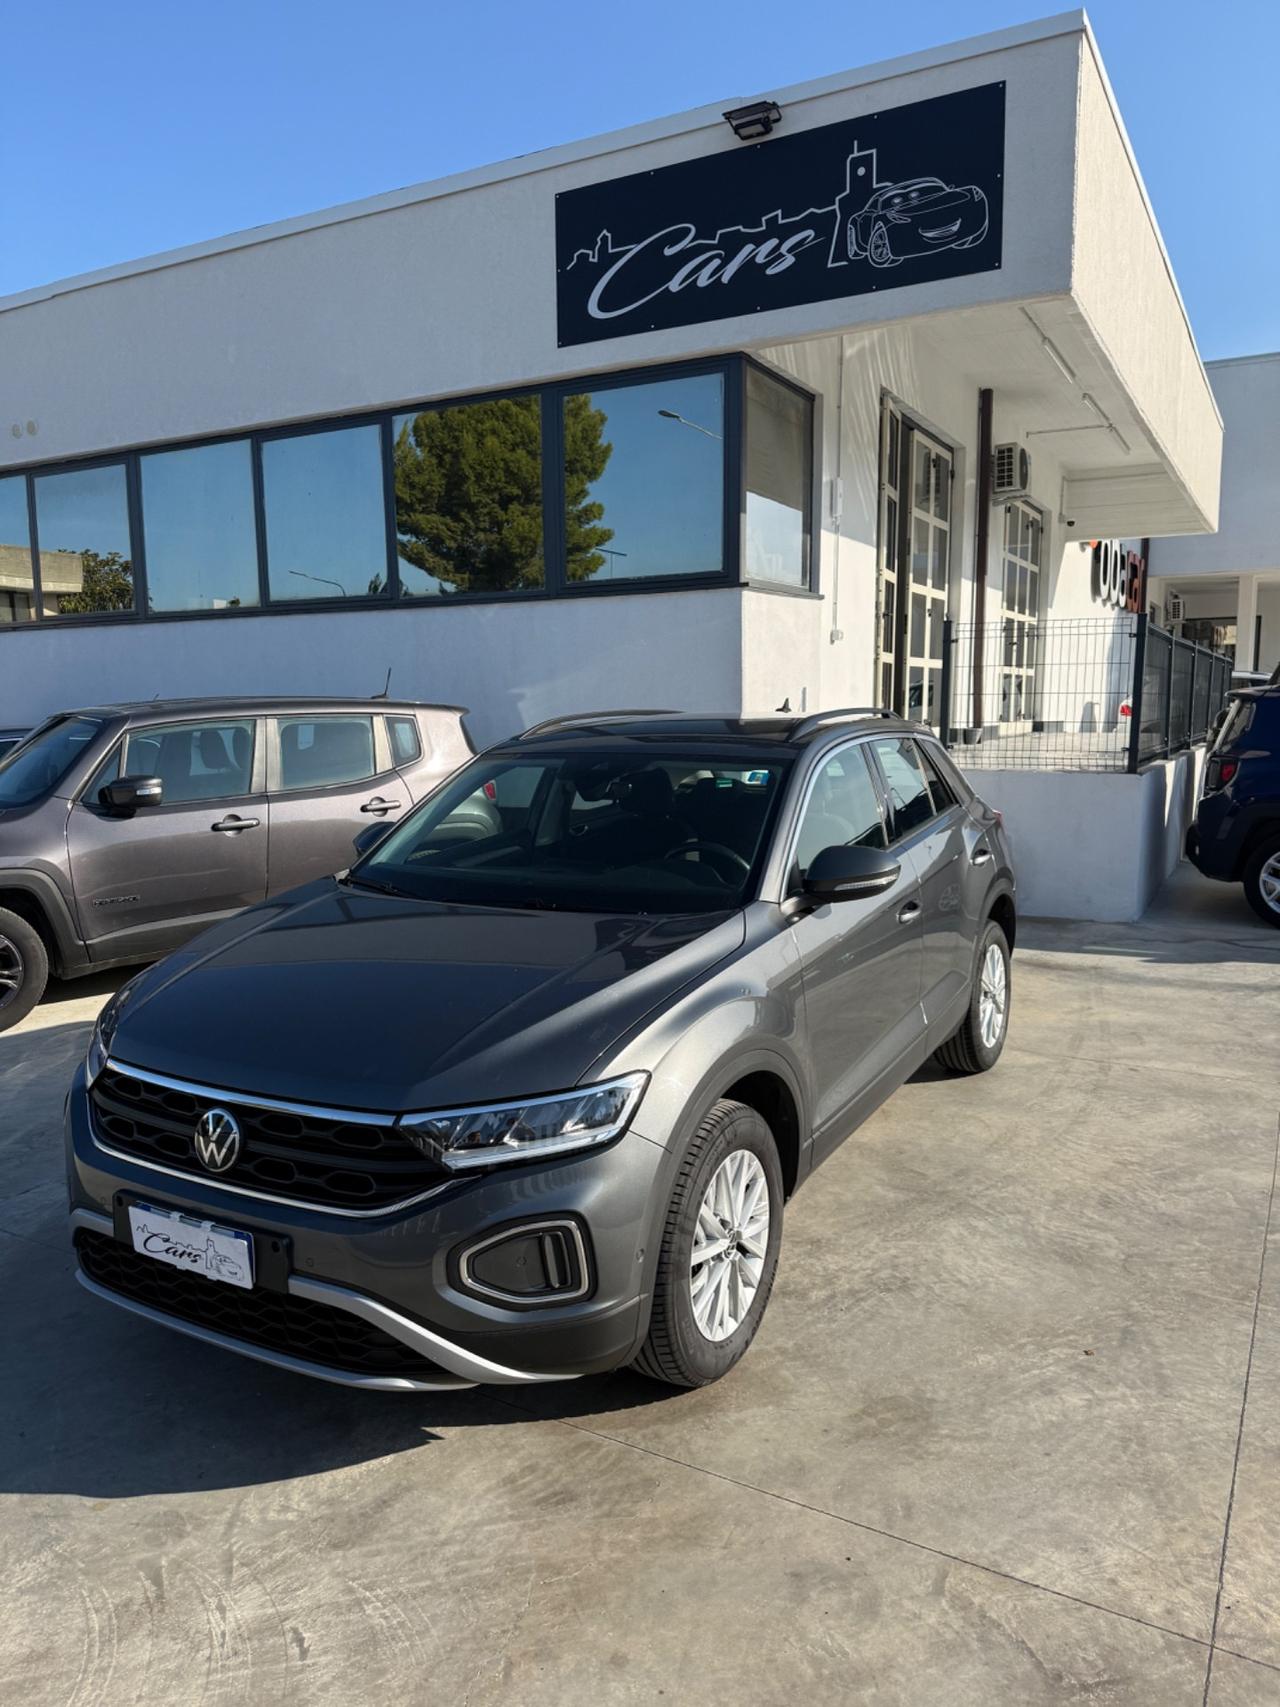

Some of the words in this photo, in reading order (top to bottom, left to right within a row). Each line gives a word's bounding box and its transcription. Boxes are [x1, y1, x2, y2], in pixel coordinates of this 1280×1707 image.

[587, 223, 823, 319] Cars
[196, 1109, 239, 1171] VW
[143, 1232, 203, 1264] Cars
